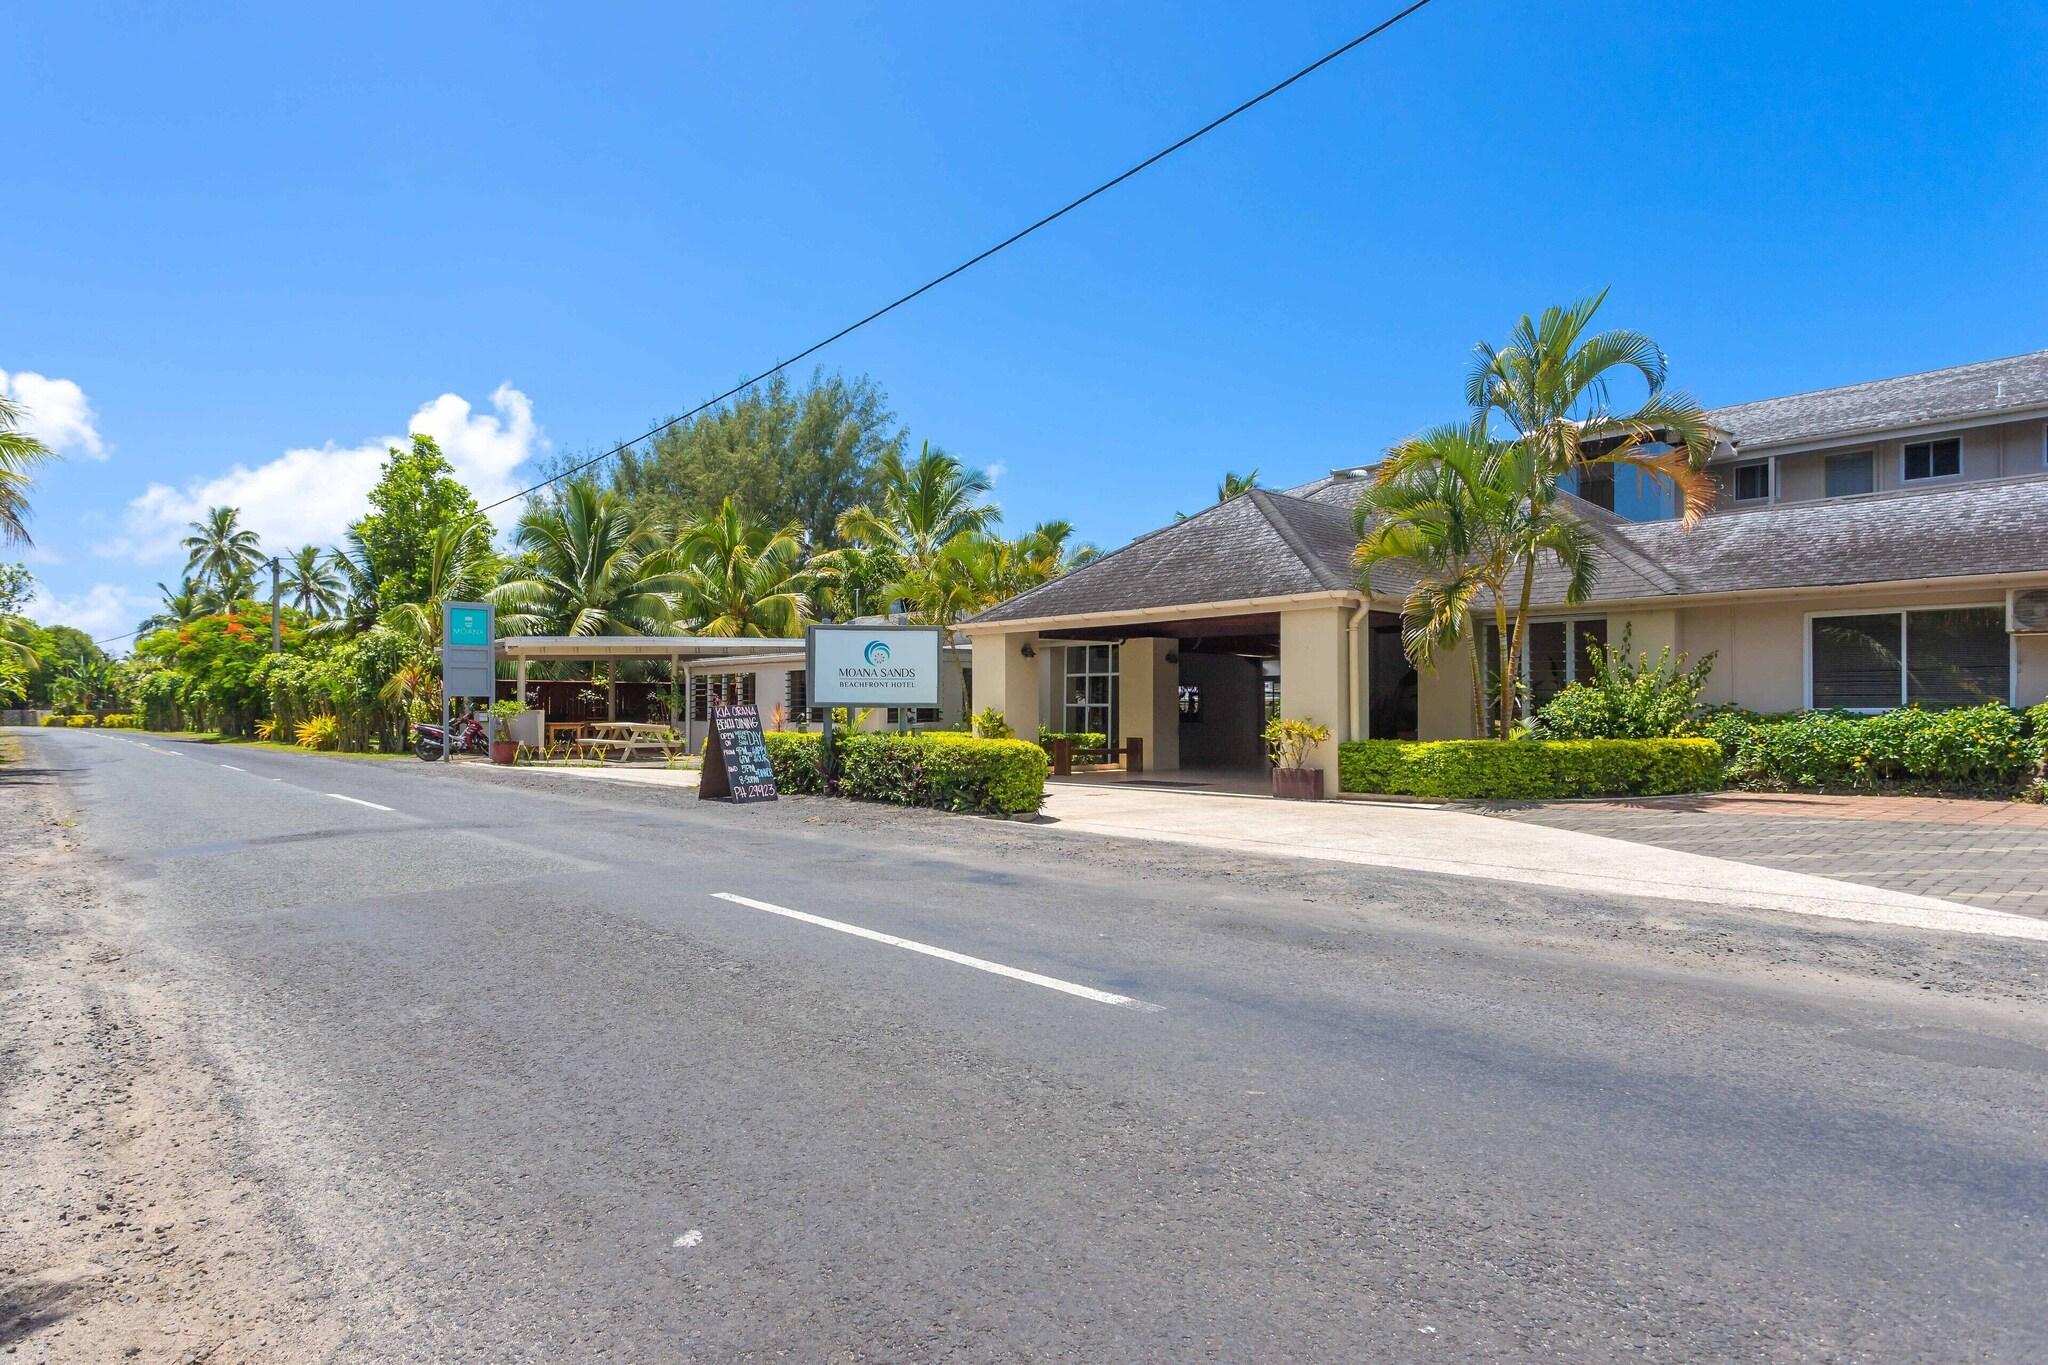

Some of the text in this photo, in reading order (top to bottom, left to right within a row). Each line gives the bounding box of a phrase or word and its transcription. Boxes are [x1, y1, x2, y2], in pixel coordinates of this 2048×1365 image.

[839, 668, 915, 677] MOANA SANDS
[716, 705, 756, 718] KIA ORANA
[716, 717, 758, 731] BEACH DINING
[746, 731, 762, 747] DAY
[734, 784, 775, 800] PH 29923
